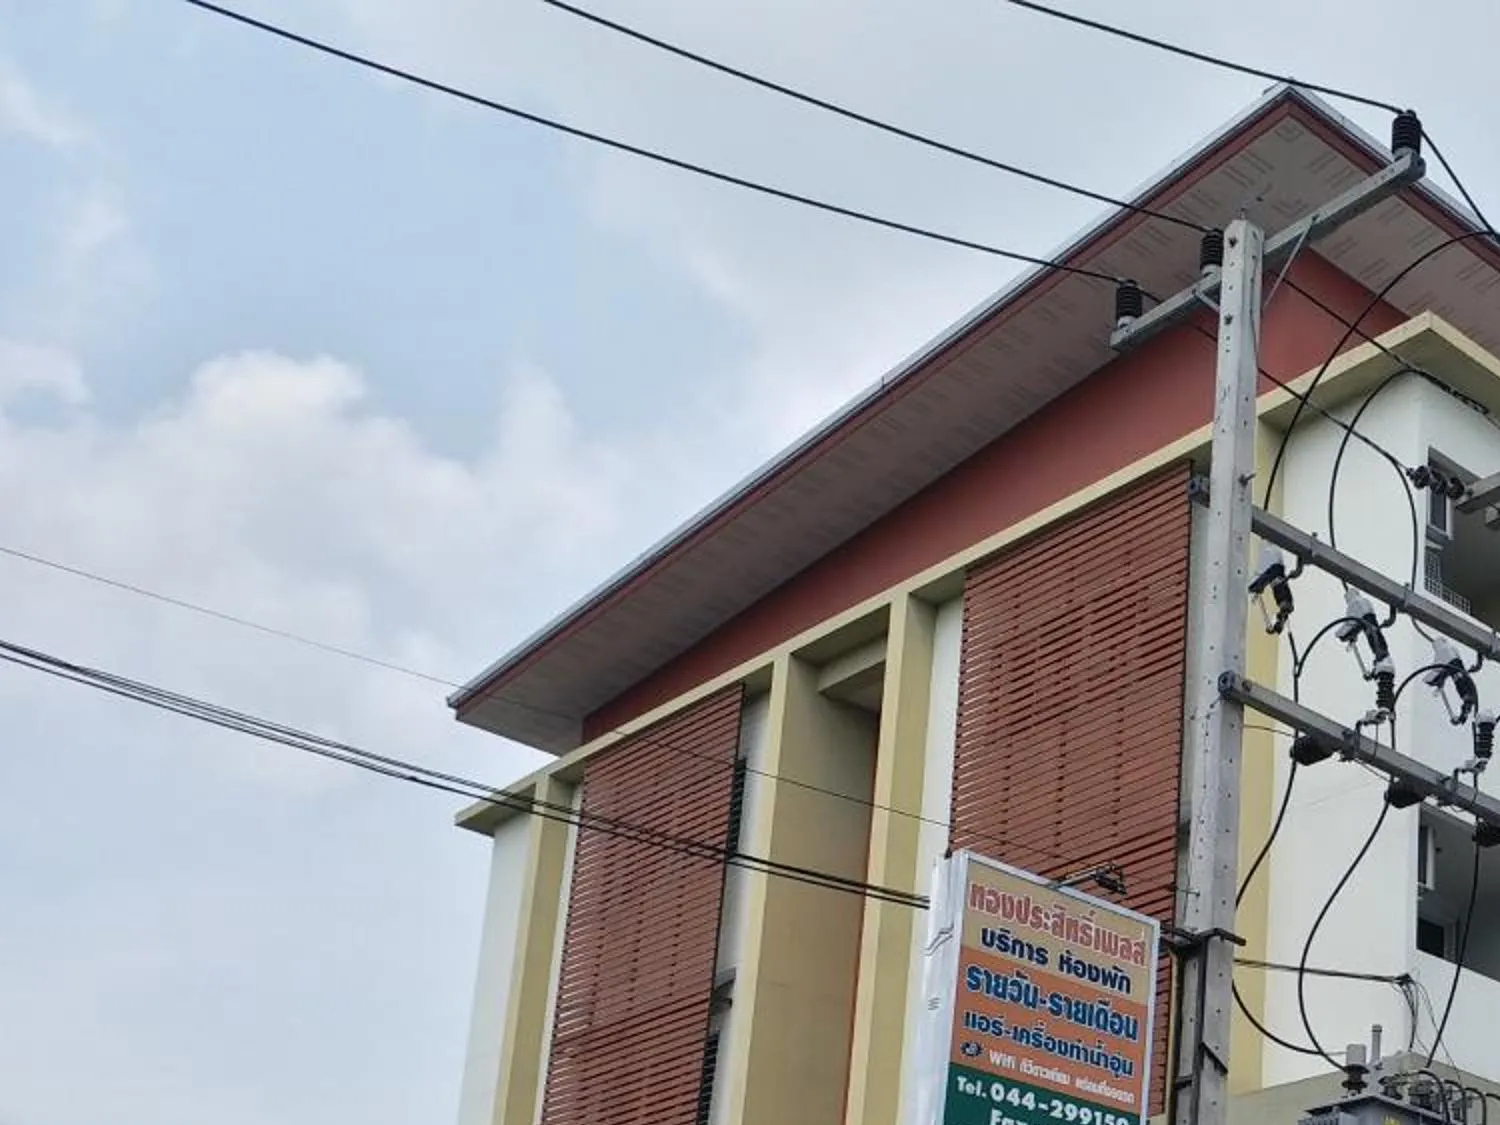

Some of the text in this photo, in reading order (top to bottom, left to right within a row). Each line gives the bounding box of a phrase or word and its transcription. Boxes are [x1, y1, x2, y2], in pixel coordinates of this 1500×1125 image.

[981, 927, 1132, 995] บริการ ห้องพัก
[966, 964, 1139, 1041] รายวัน-รายเดือน
[957, 1076, 988, 1098] Tel.
